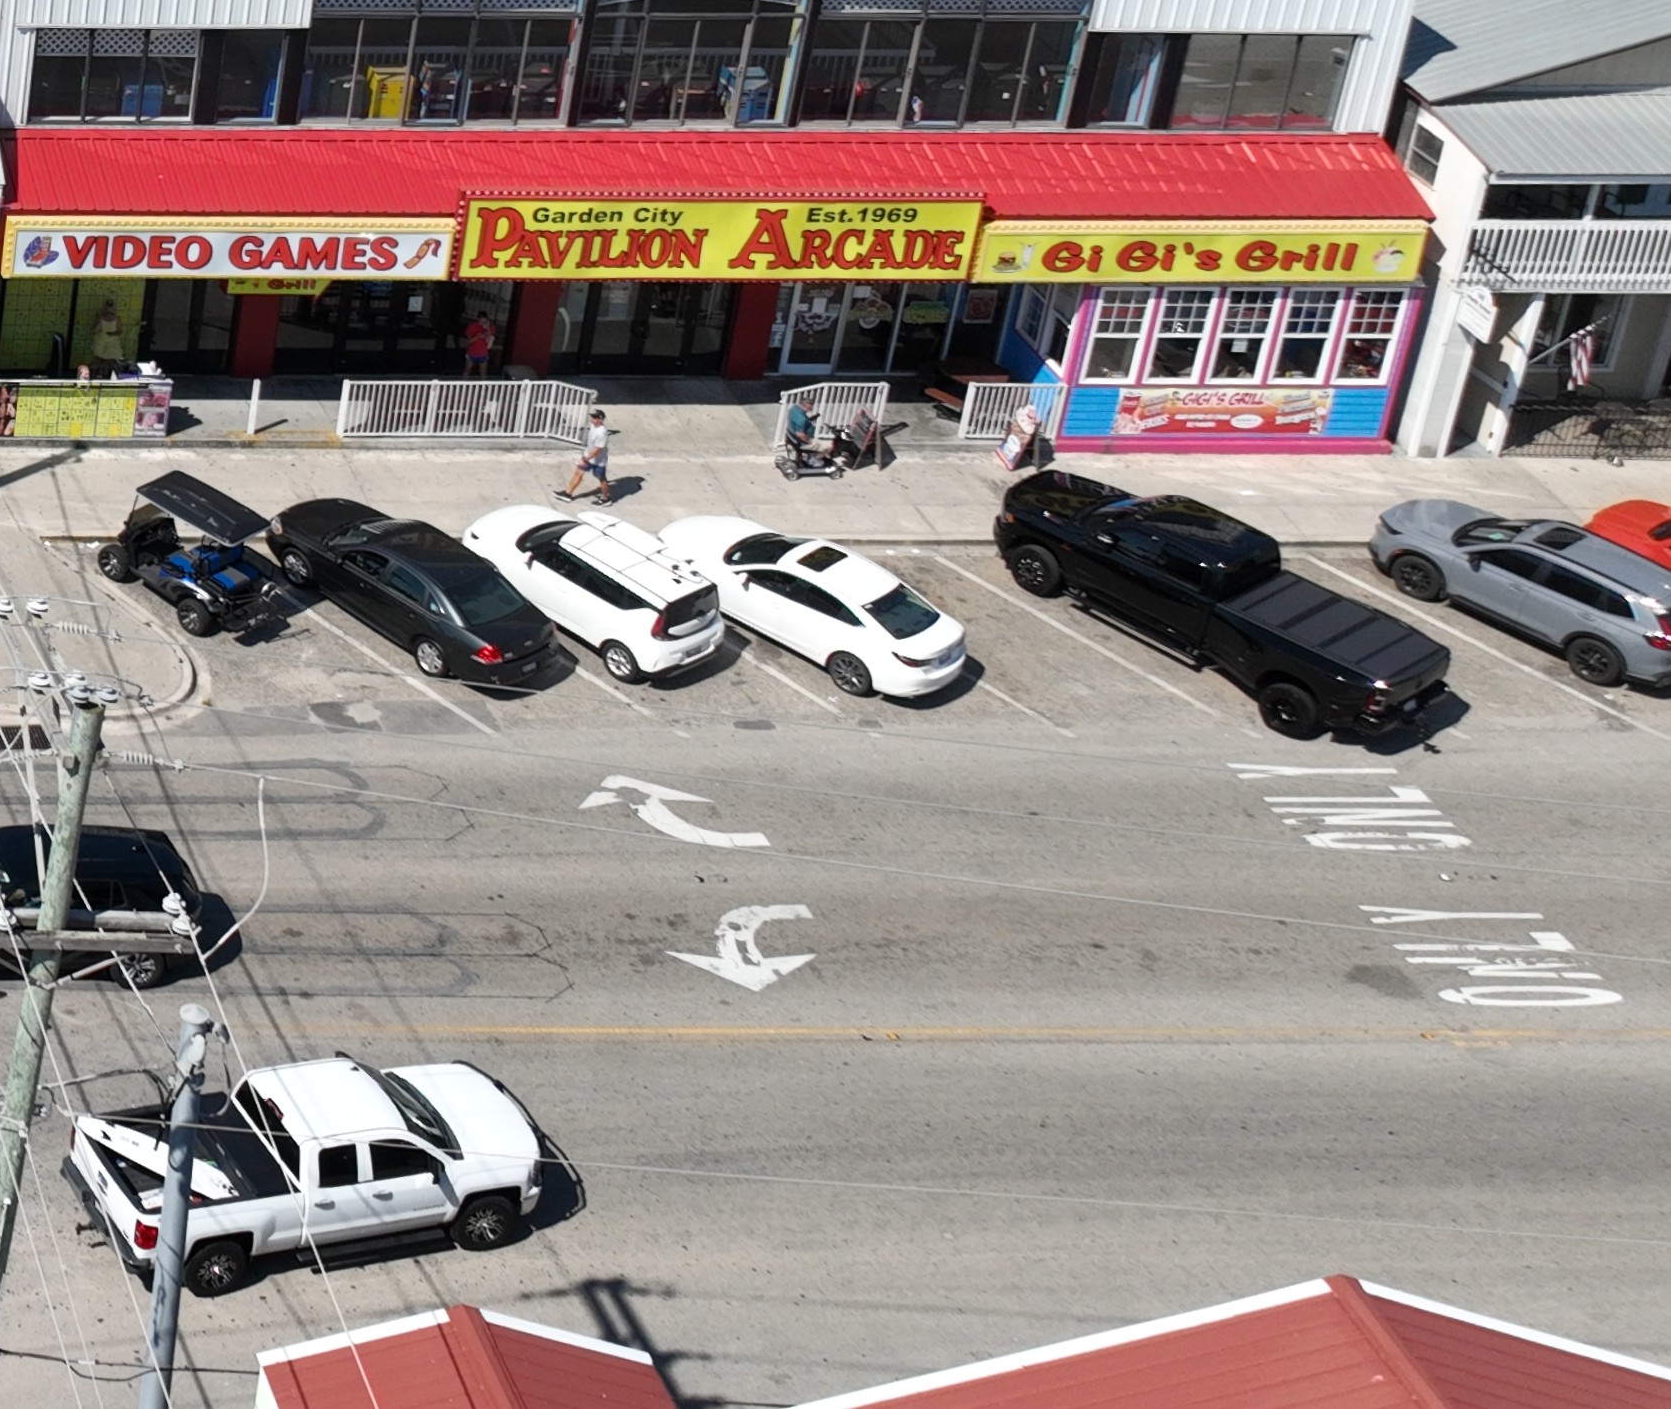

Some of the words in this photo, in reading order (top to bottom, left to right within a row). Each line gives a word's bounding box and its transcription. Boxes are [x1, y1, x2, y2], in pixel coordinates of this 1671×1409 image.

[532, 207, 622, 224] Garden
[634, 207, 683, 226] City
[62, 235, 213, 270] VIDEO
[228, 236, 398, 271] GAMES
[470, 206, 708, 270] PAVILION
[729, 208, 965, 271] ARCADE
[1041, 240, 1103, 273] Gi
[1115, 240, 1222, 272] Gi's
[1235, 240, 1359, 273] Grill
[1182, 392, 1226, 406] GIGI'S
[1228, 392, 1266, 406] GRILL
[1226, 762, 1472, 850] ONLY
[1358, 905, 1623, 1007] ONLY
